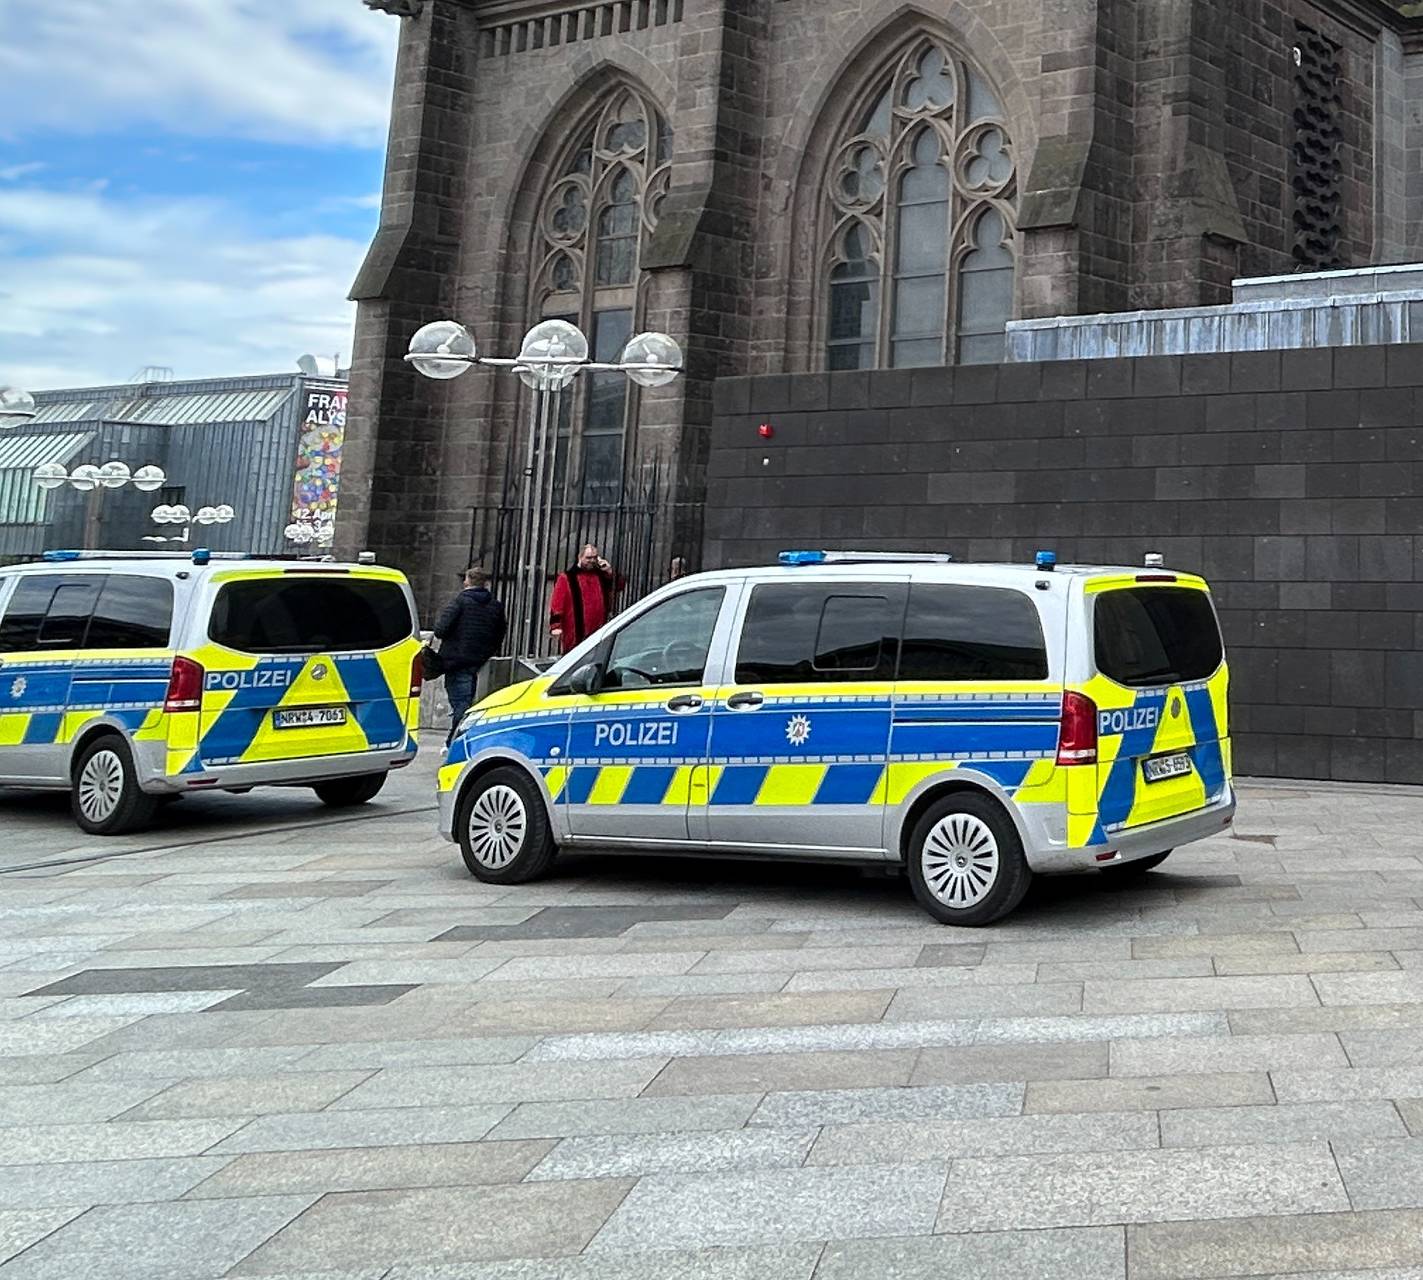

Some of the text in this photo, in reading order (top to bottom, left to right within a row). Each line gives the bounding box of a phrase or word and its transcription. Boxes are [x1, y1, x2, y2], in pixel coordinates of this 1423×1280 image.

[206, 670, 291, 689] POLIZEI
[1100, 706, 1159, 734] POLIZEI
[594, 721, 679, 747] POLIZEI
